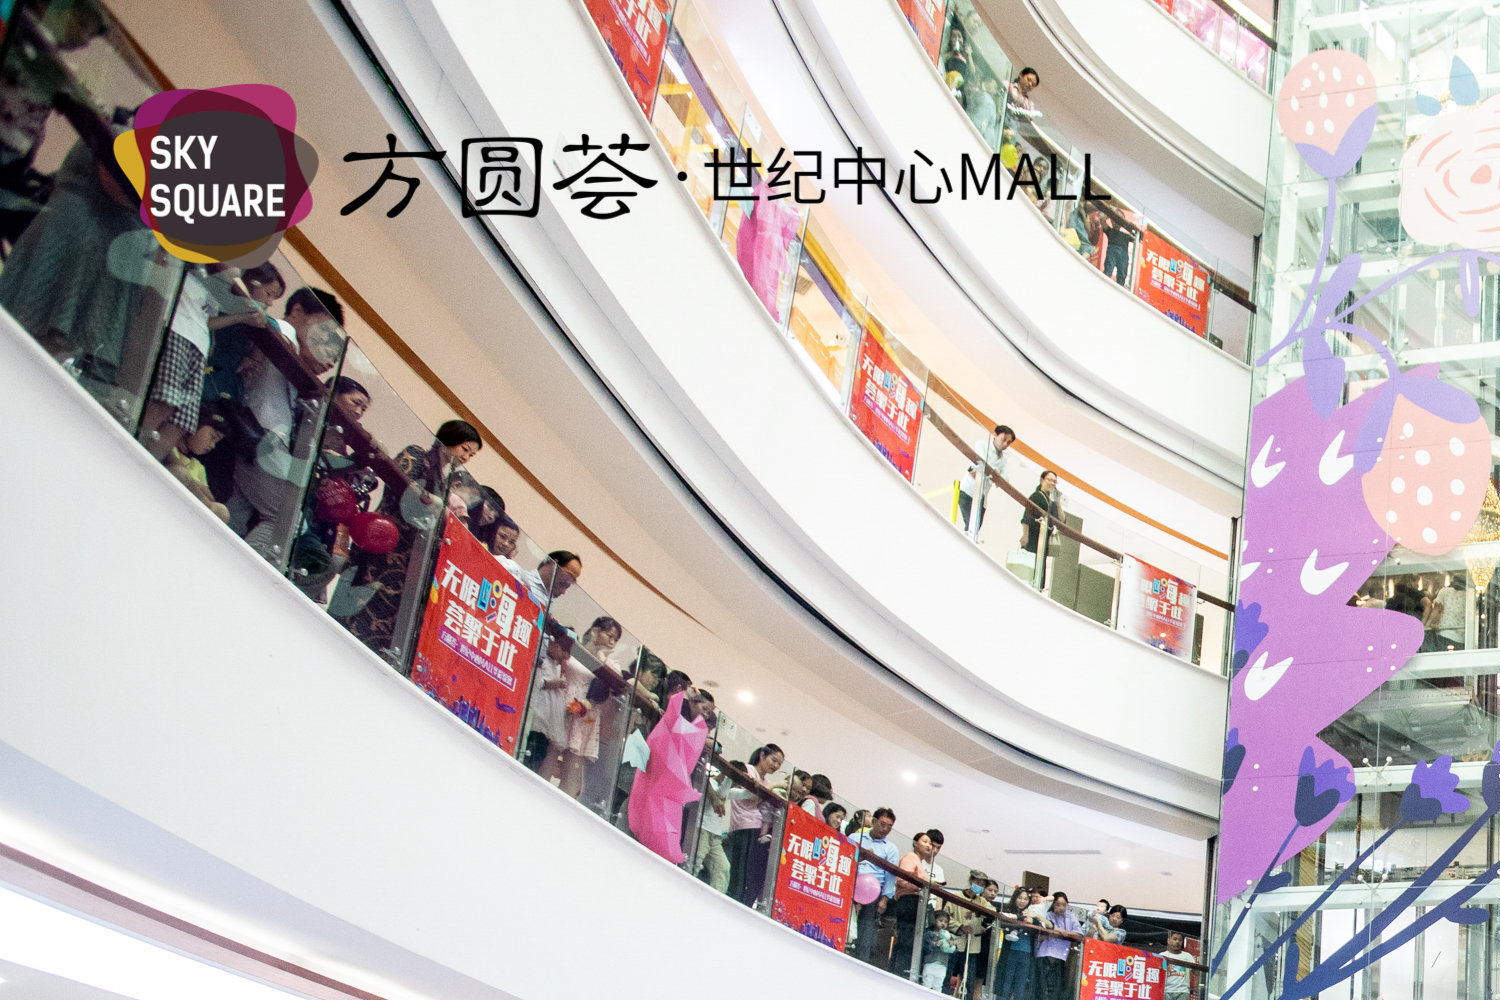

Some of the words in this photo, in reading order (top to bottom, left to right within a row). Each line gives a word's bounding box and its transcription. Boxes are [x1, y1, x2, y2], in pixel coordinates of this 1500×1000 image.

[444, 599, 518, 672] 荟聚于此
[791, 858, 843, 895] 荟聚于此
[1095, 979, 1152, 1000] 荟聚于此
